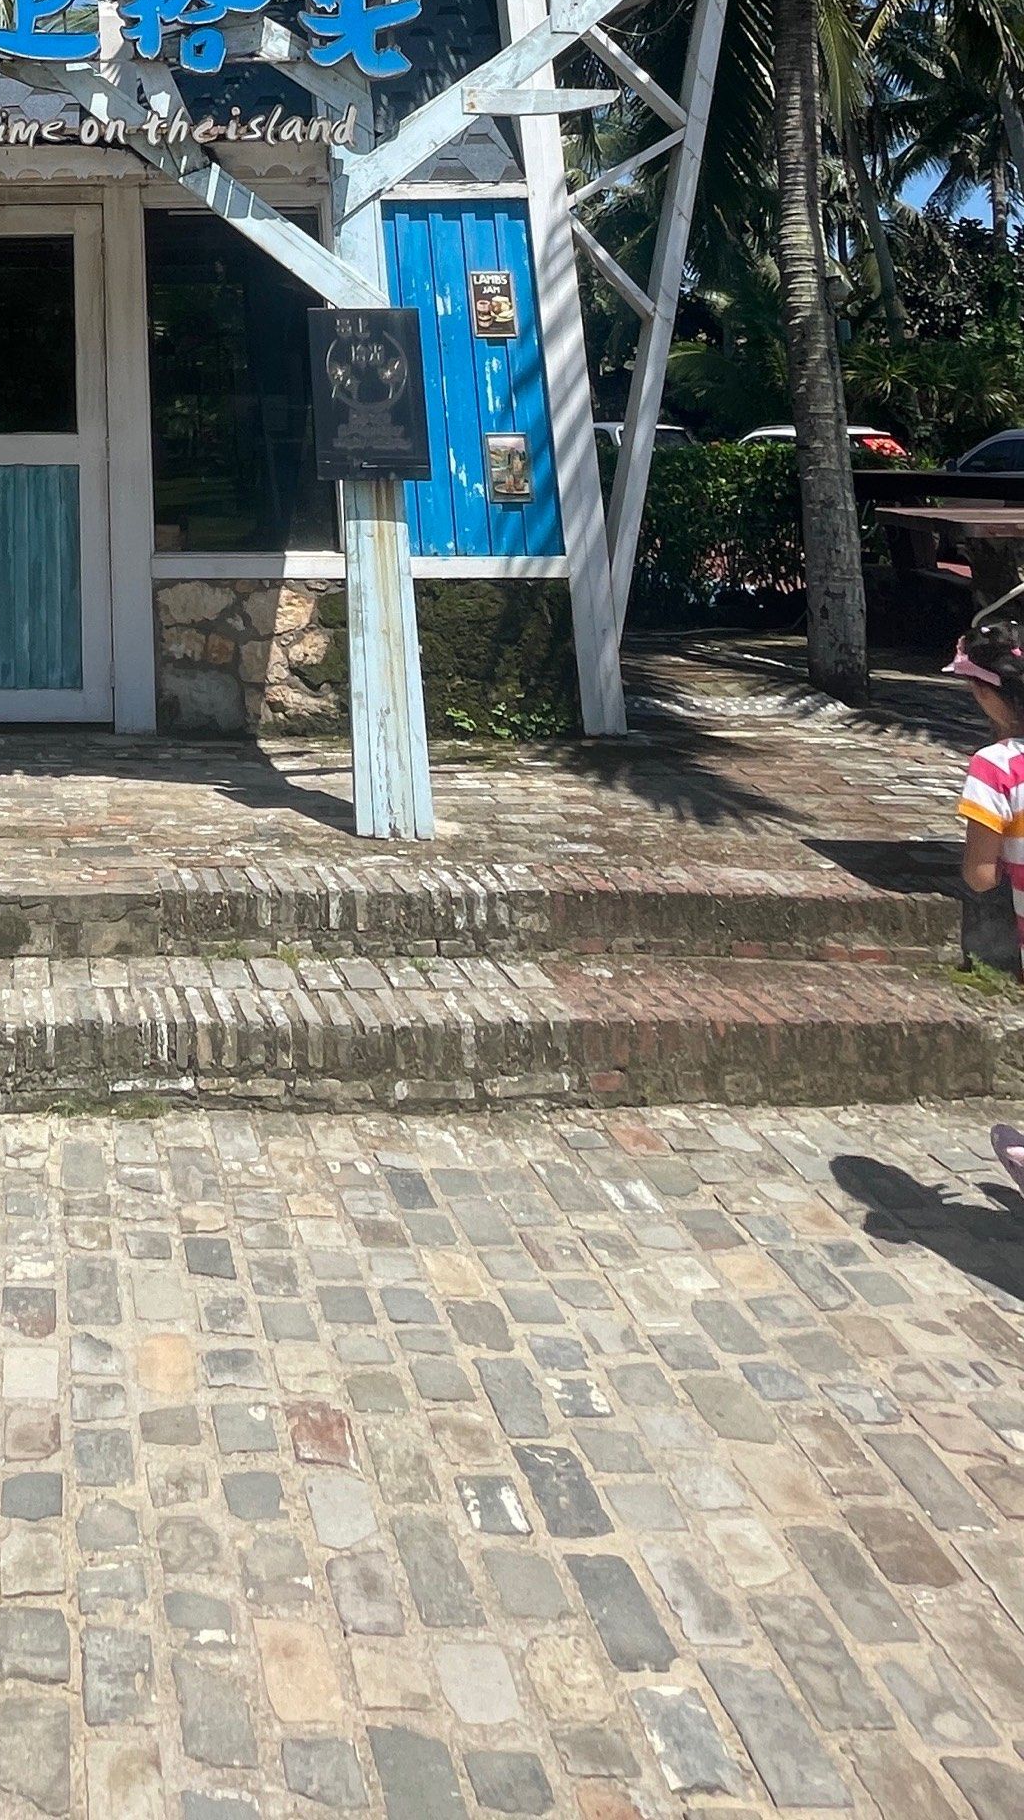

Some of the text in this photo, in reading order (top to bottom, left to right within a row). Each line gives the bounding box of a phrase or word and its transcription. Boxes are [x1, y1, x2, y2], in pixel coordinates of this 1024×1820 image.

[79, 116, 127, 145] on
[144, 106, 215, 146] the
[226, 103, 358, 148] island
[473, 274, 508, 285] LAMBS
[482, 286, 501, 294] JAM
